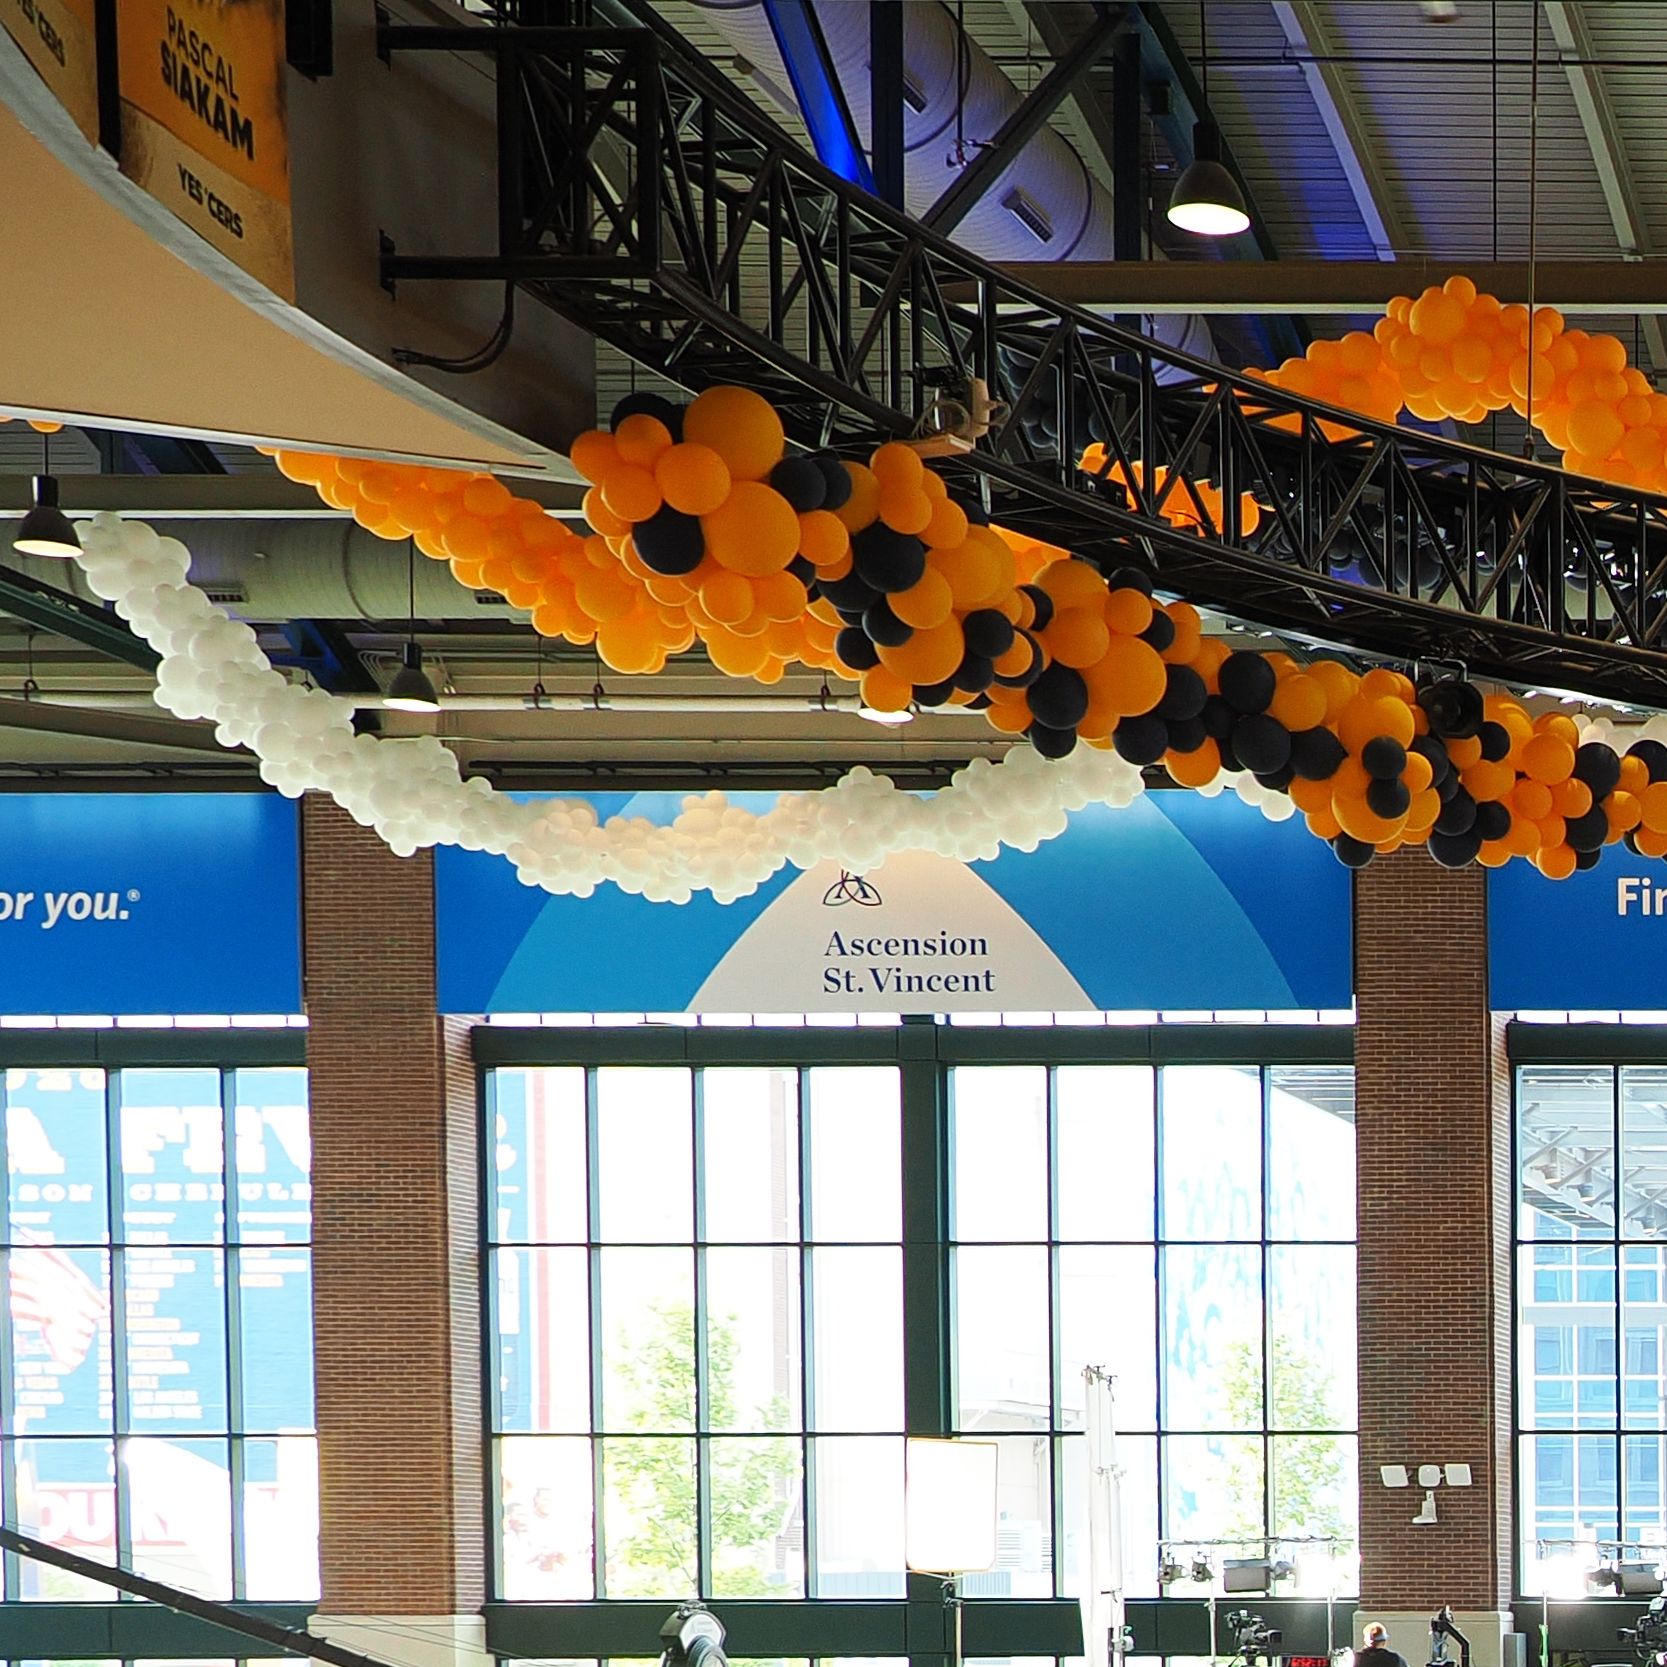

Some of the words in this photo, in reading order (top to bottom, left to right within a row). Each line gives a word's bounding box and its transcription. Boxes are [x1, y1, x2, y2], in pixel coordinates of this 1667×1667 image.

[166, 4, 239, 102] PASCAL
[161, 39, 254, 161] SIAKAM
[178, 163, 204, 206] YES
[824, 931, 989, 956] Ascension
[823, 967, 864, 993] St.
[868, 967, 997, 993] Vincent
